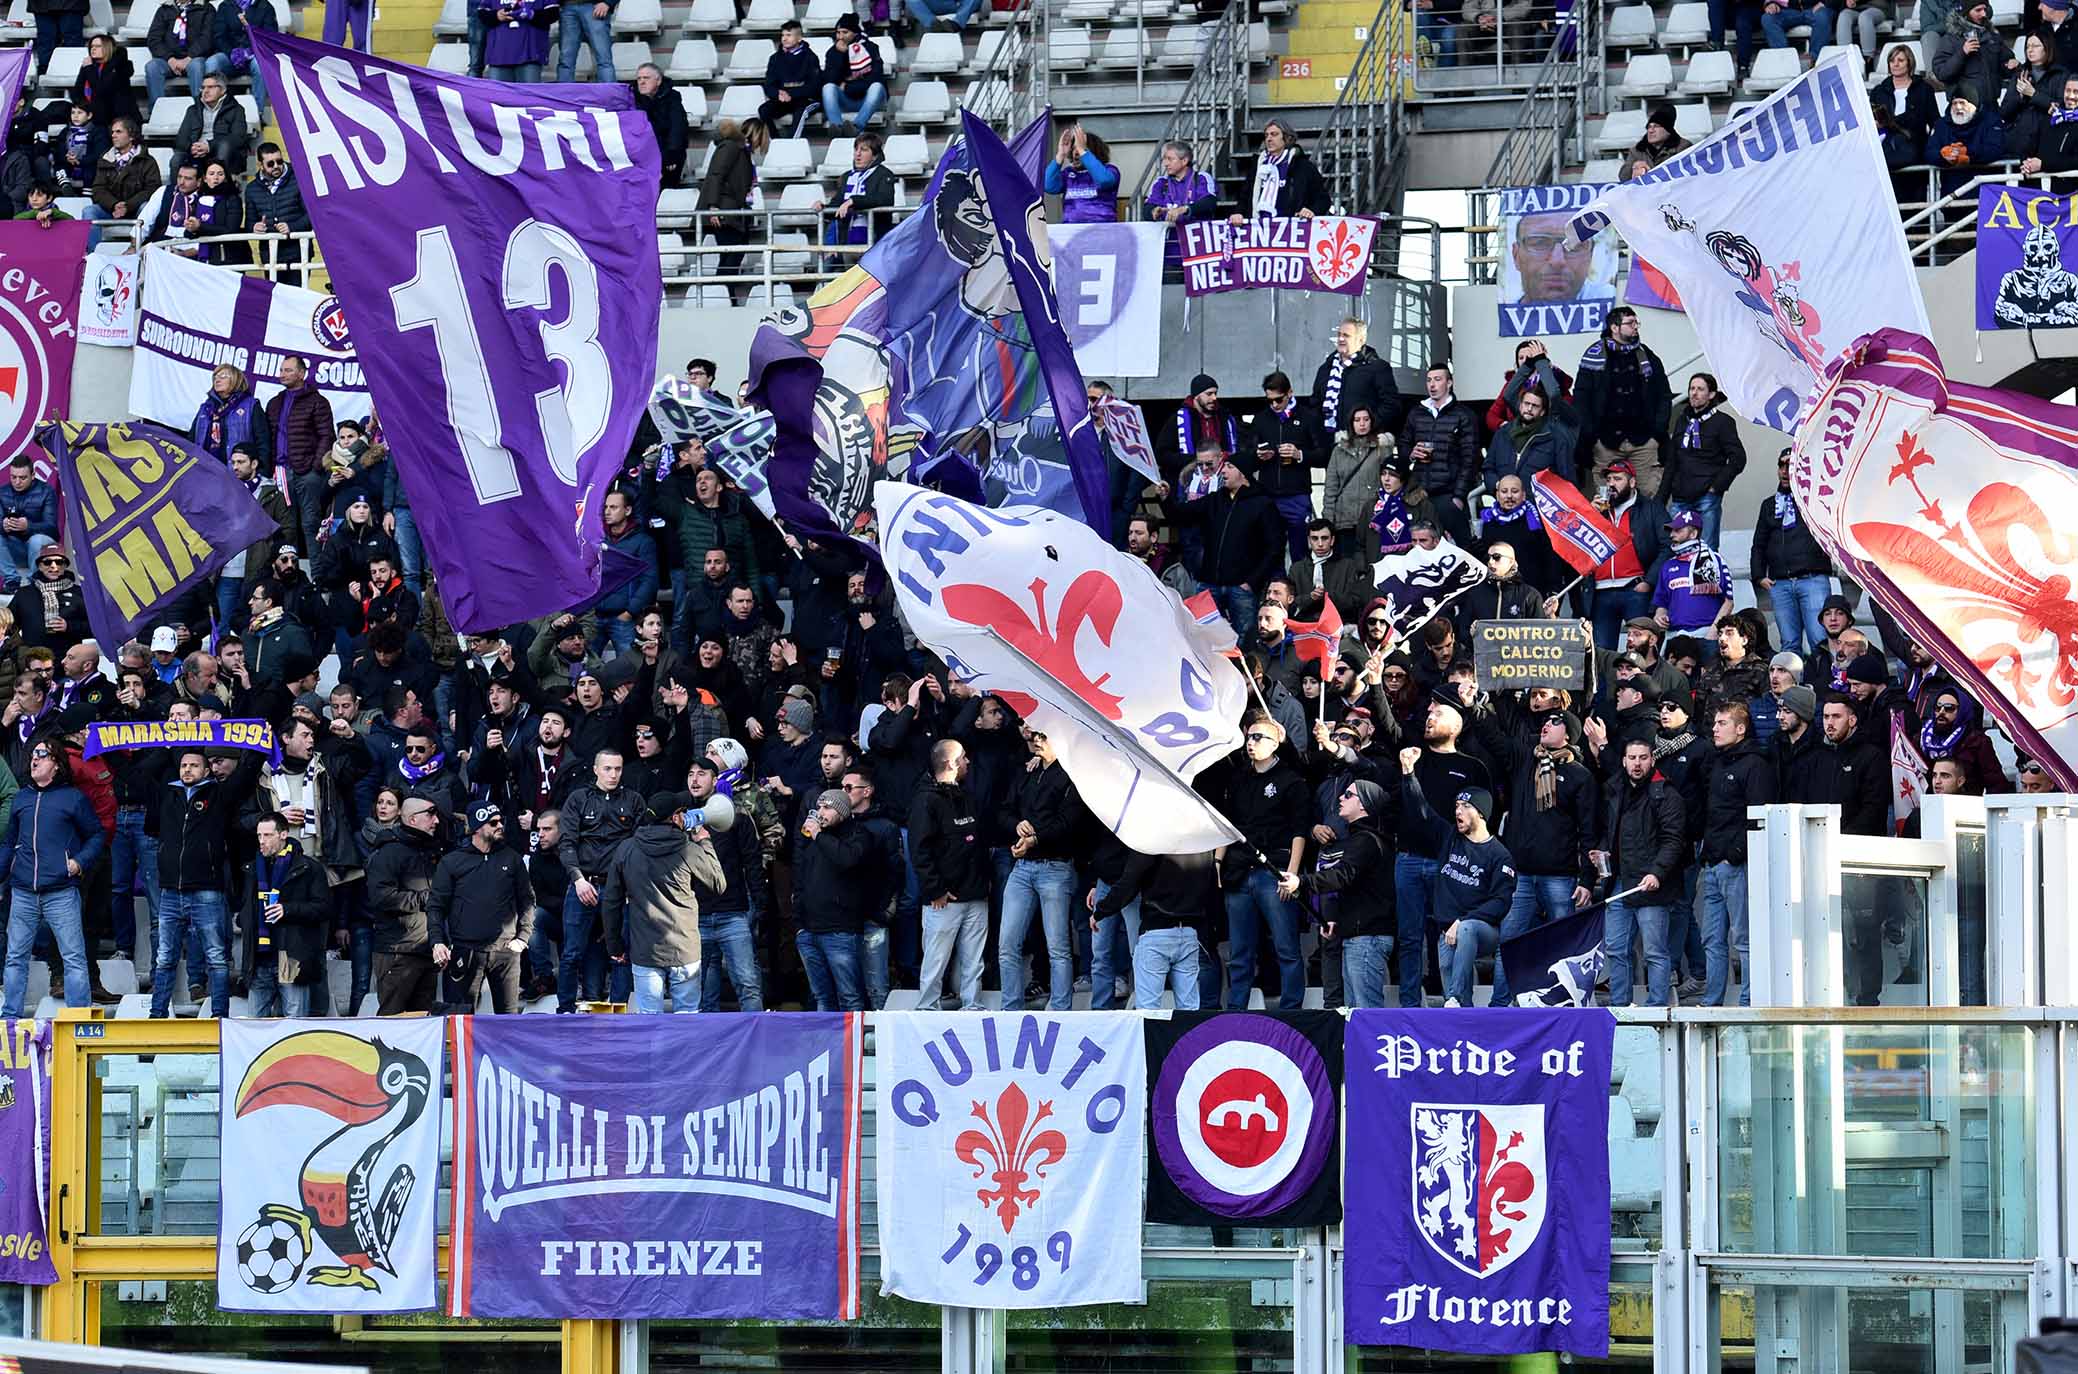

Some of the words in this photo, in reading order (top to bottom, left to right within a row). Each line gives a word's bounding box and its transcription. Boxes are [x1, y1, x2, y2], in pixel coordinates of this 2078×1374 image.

[1283, 63, 1310, 77] 236
[1185, 216, 1306, 257] FIRENZE
[1191, 260, 1233, 291] NEL
[1242, 256, 1304, 284] NORD
[140, 318, 249, 372] SURROUNDING
[388, 217, 613, 505] 13
[95, 500, 215, 623] MA
[1483, 627, 1556, 640] CONTRO
[1561, 628, 1580, 641] IL
[1502, 646, 1563, 659] CALCIO
[1491, 665, 1574, 678] MODERNO
[98, 722, 213, 748] MARASMA
[77, 1026, 85, 1036] A
[89, 1026, 101, 1036] 14
[891, 1014, 1127, 1134] QUINTO
[1374, 1034, 1517, 1079] Pride
[1541, 1040, 1585, 1077] of
[477, 1053, 609, 1223] QUELLI
[625, 1114, 666, 1175] DI
[682, 1050, 829, 1196] SEMPRE
[540, 1240, 763, 1276] FIRENZE
[941, 1222, 1072, 1290] 1989
[1380, 1283, 1573, 1327] Florence
